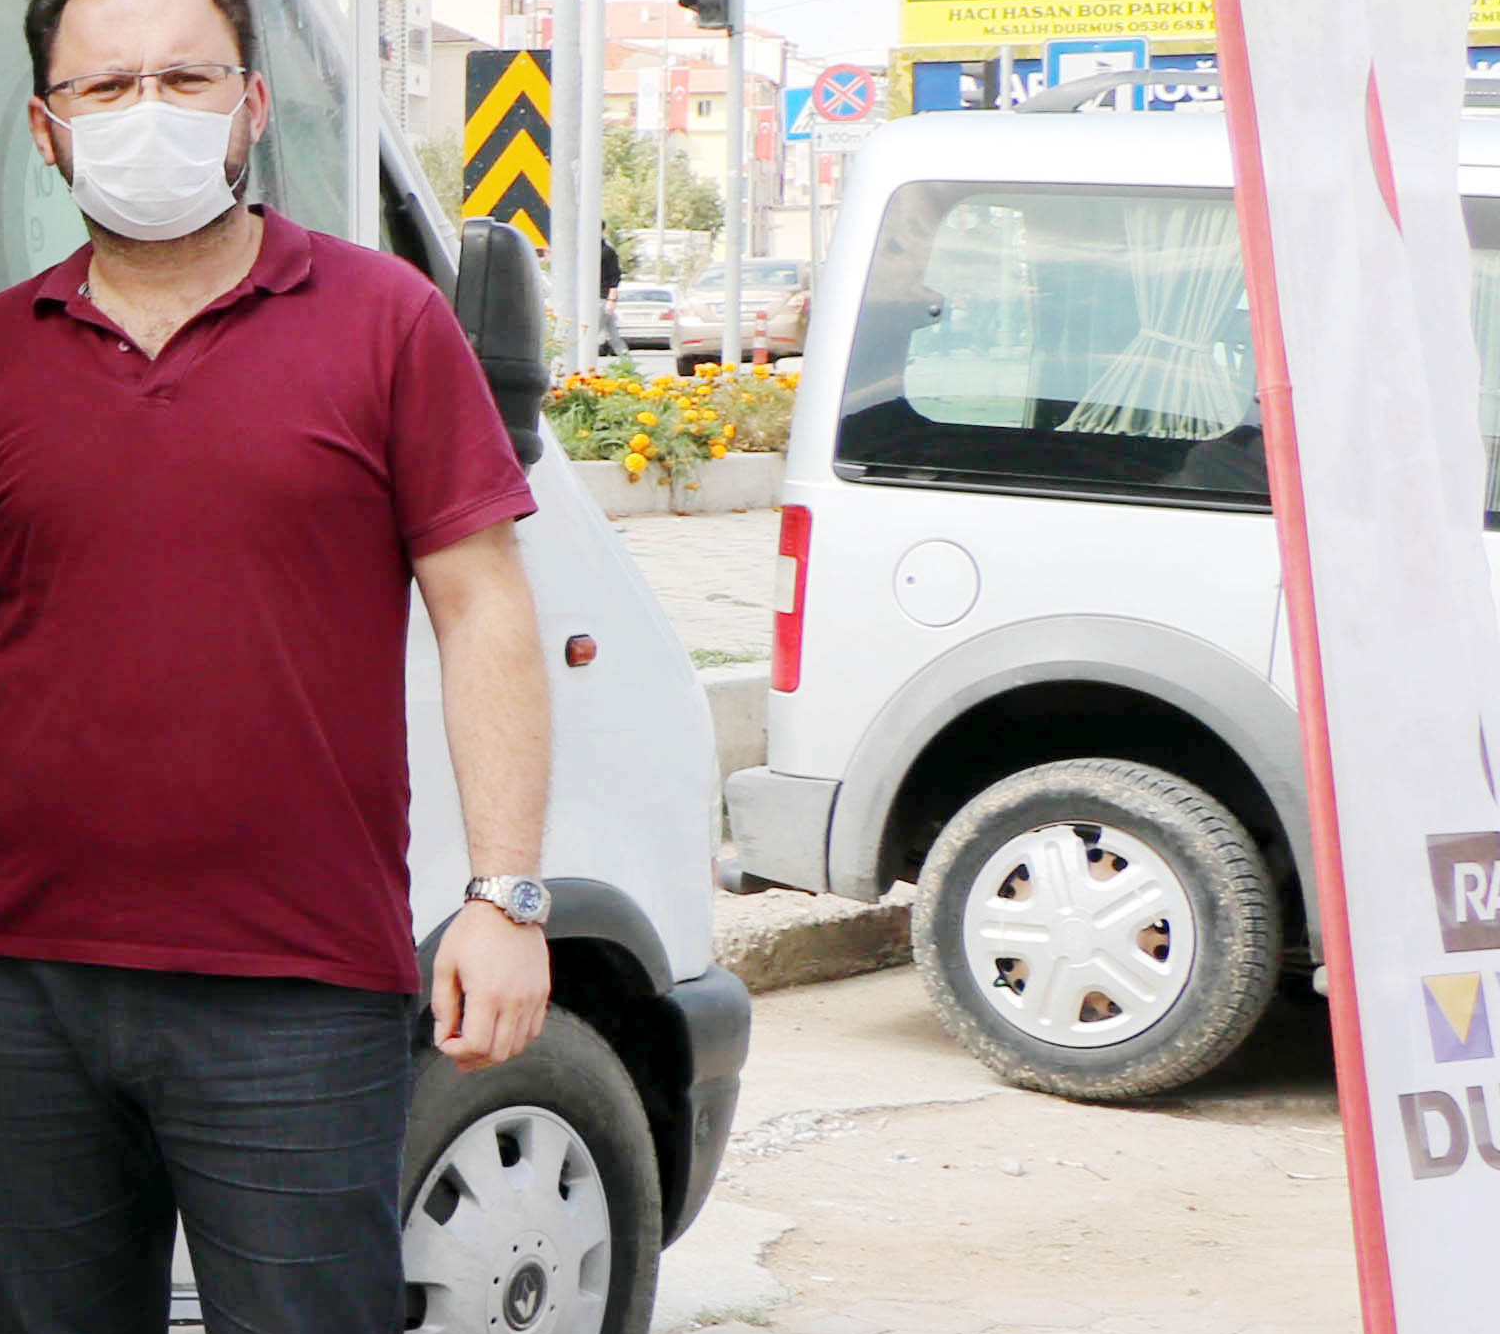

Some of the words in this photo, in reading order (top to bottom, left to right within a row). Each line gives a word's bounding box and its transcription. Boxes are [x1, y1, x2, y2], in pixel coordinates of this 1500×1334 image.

[948, 7, 997, 22] HACI
[1002, 4, 1072, 20] HASAN
[1077, 3, 1122, 18] BOR
[1128, 0, 1193, 16] PARKI
